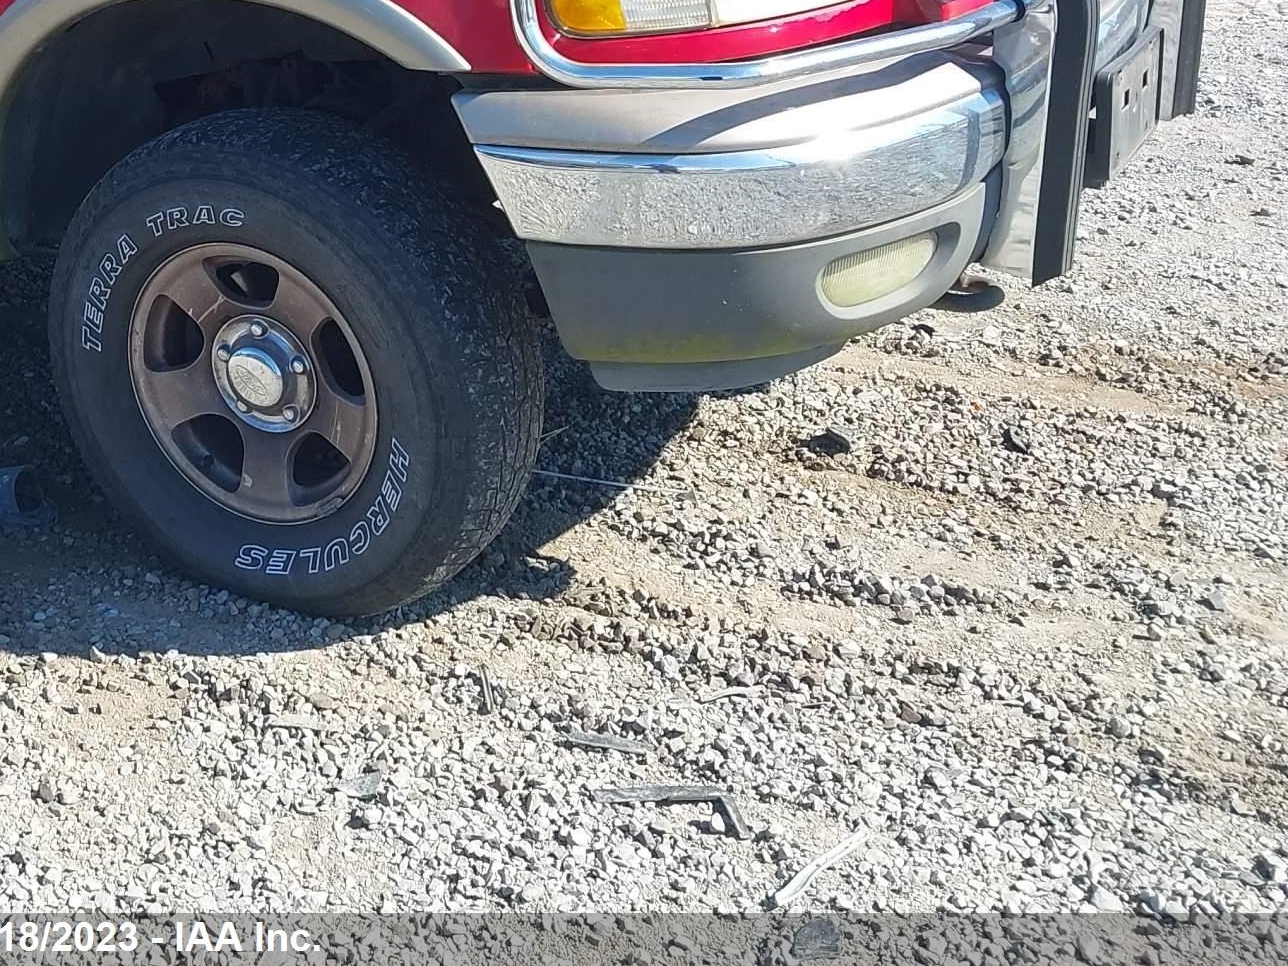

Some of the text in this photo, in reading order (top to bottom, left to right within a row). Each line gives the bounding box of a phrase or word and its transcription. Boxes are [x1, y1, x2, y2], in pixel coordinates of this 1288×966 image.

[81, 205, 245, 353] TERRA TRAC
[234, 436, 410, 575] HERCULES
